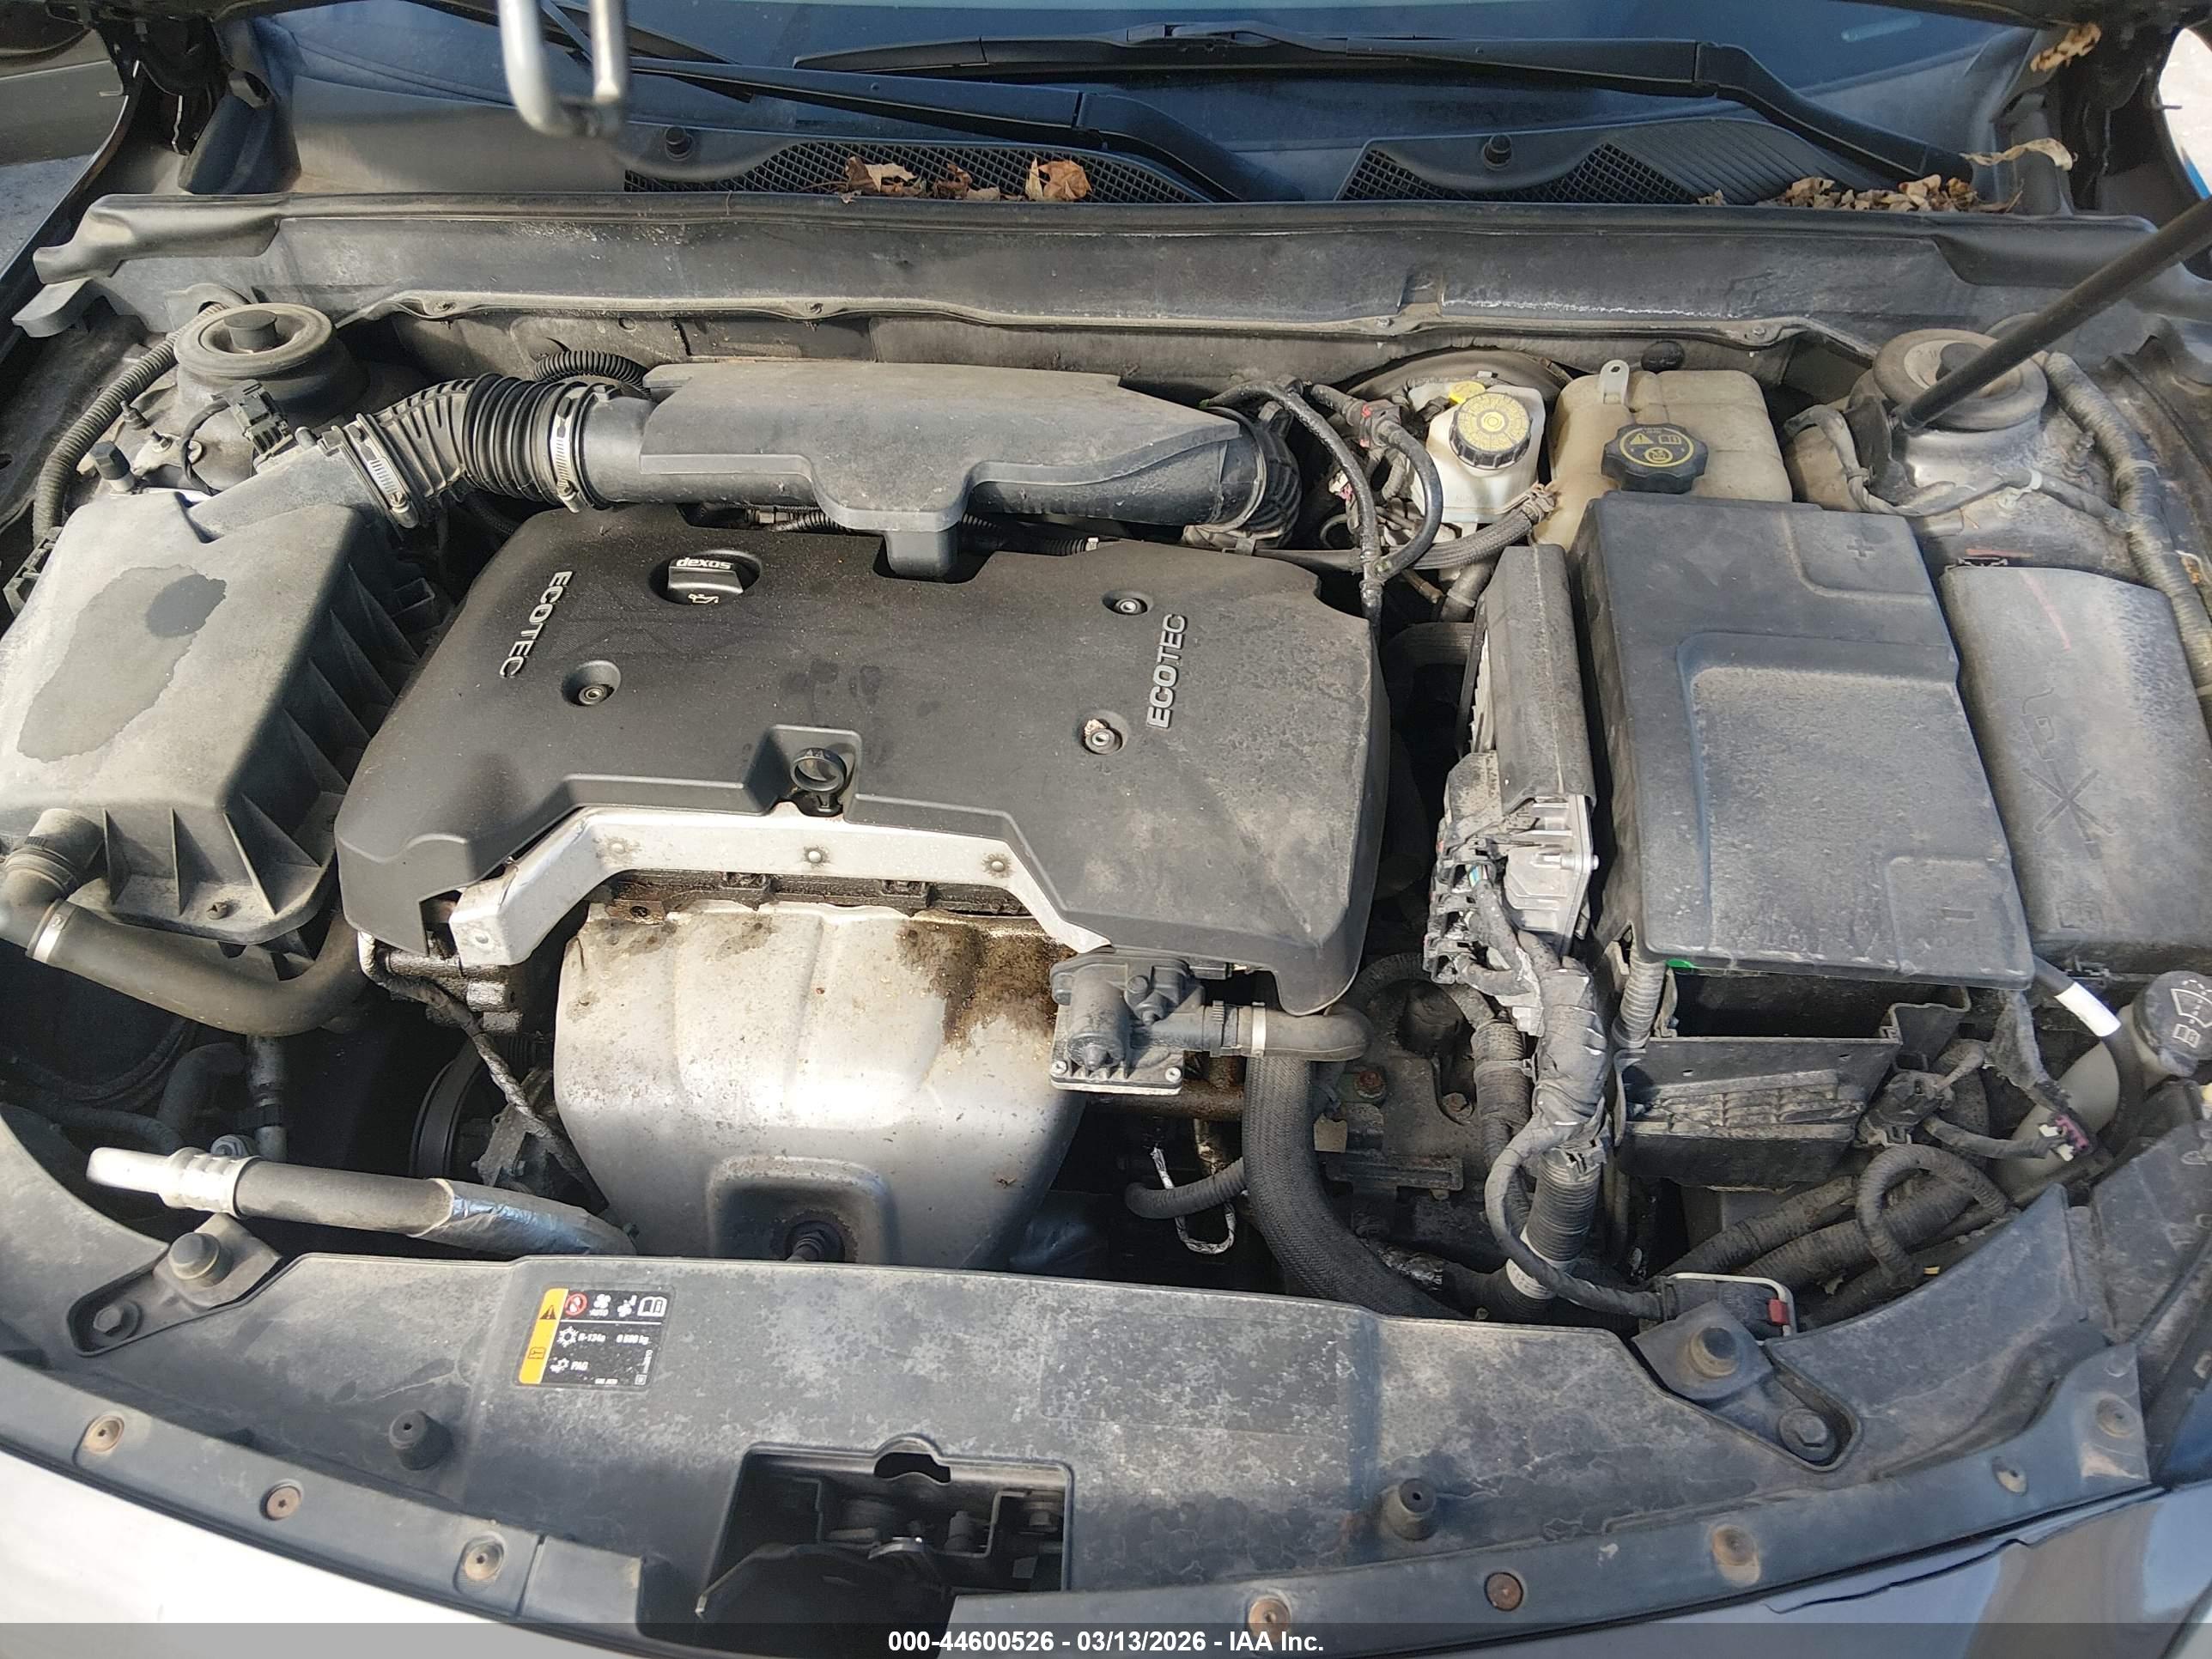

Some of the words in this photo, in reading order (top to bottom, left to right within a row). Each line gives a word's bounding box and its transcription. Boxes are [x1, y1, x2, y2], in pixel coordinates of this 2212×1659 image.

[676, 556, 734, 570] dexos
[499, 570, 573, 677] ECOTEC
[1146, 613, 1187, 728] ECOTEC
